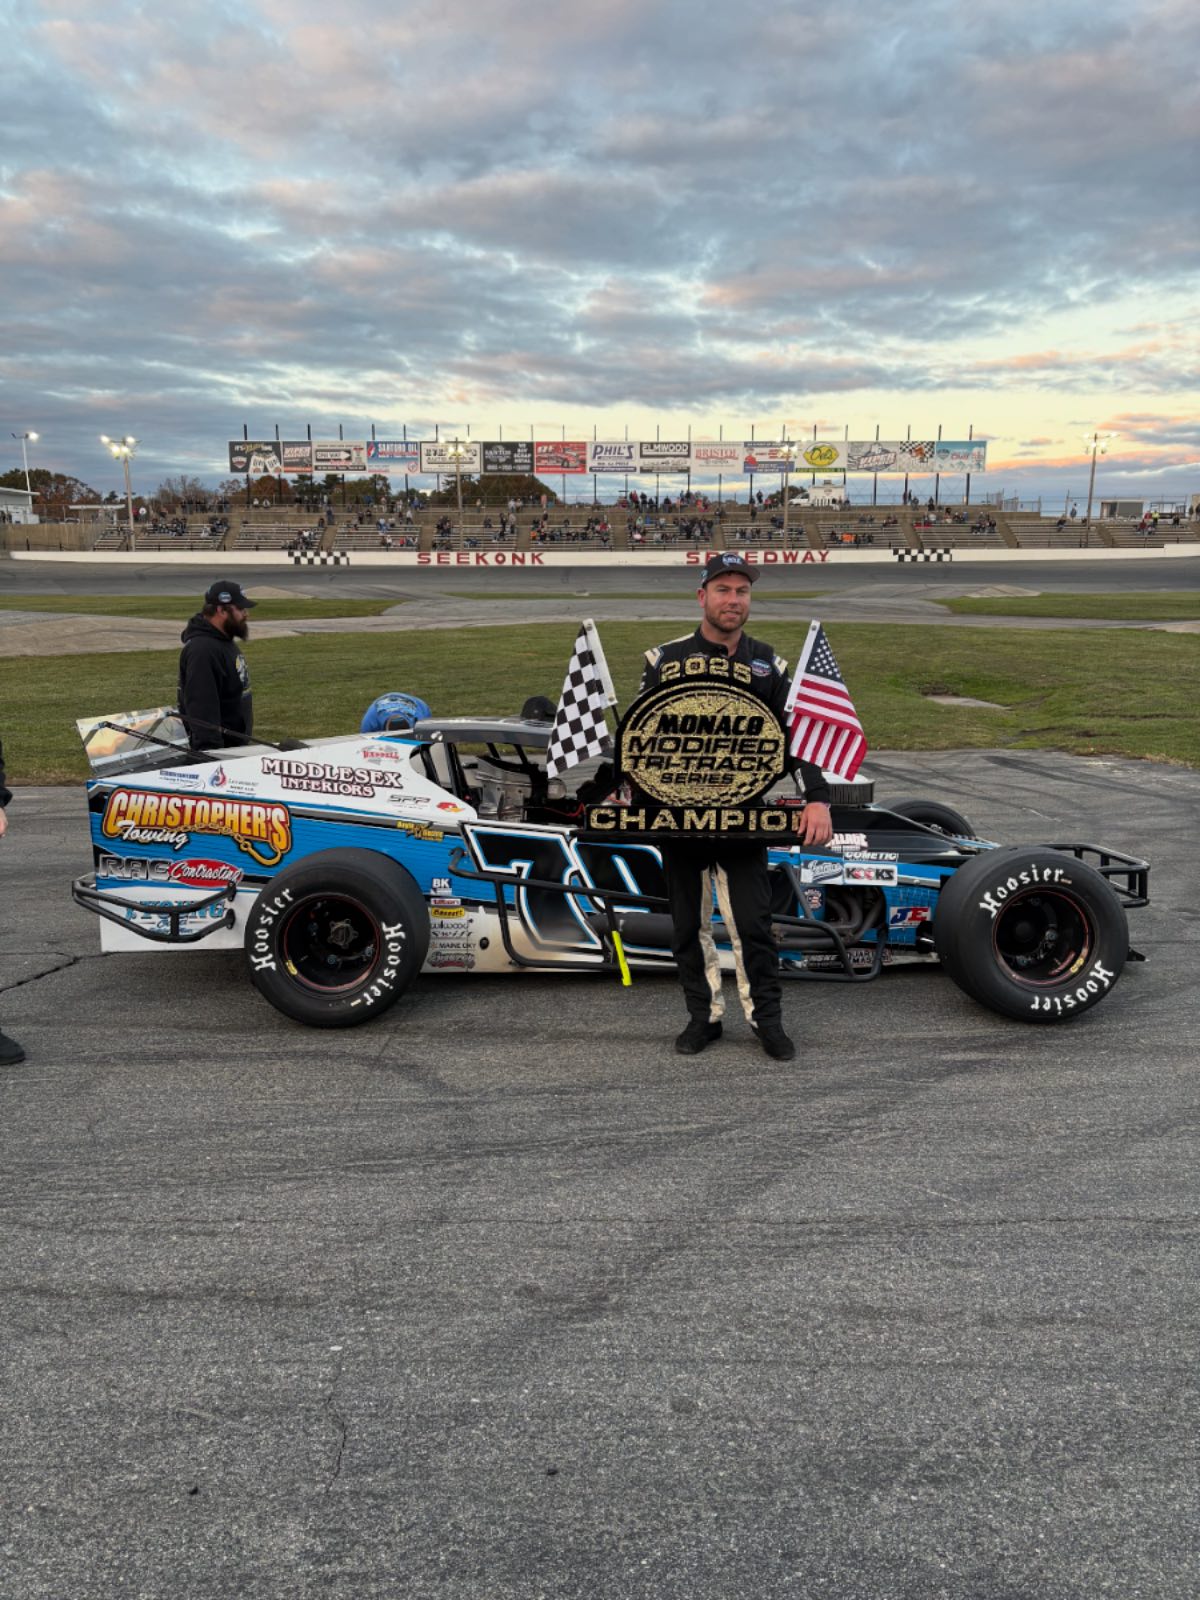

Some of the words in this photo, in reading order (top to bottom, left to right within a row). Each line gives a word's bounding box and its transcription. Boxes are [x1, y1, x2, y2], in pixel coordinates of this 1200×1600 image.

[592, 444, 635, 459] PHIL'S
[642, 443, 689, 451] ELMWOOD
[417, 552, 544, 565] SEEKONK
[686, 551, 830, 565] SPEDWAY
[660, 656, 752, 685] 2025
[656, 713, 764, 735] MONACO
[628, 736, 780, 754] MODIFIED
[262, 757, 403, 789] MIDDLESEX
[628, 755, 777, 772] TRI-TRACK
[281, 776, 374, 797] INTERIORS
[660, 772, 736, 785] SERIES
[106, 791, 287, 851] CHRISTOPHER'S
[117, 820, 188, 849] Towing
[171, 861, 243, 885] Contracting
[432, 878, 450, 888] BK
[846, 867, 895, 881] KOOKS
[979, 863, 1065, 919] Hoosier
[890, 907, 929, 925] JE
[250, 888, 294, 972] Hoosier
[363, 921, 406, 1006] Hoosier
[1030, 959, 1115, 1016] Hoosier
